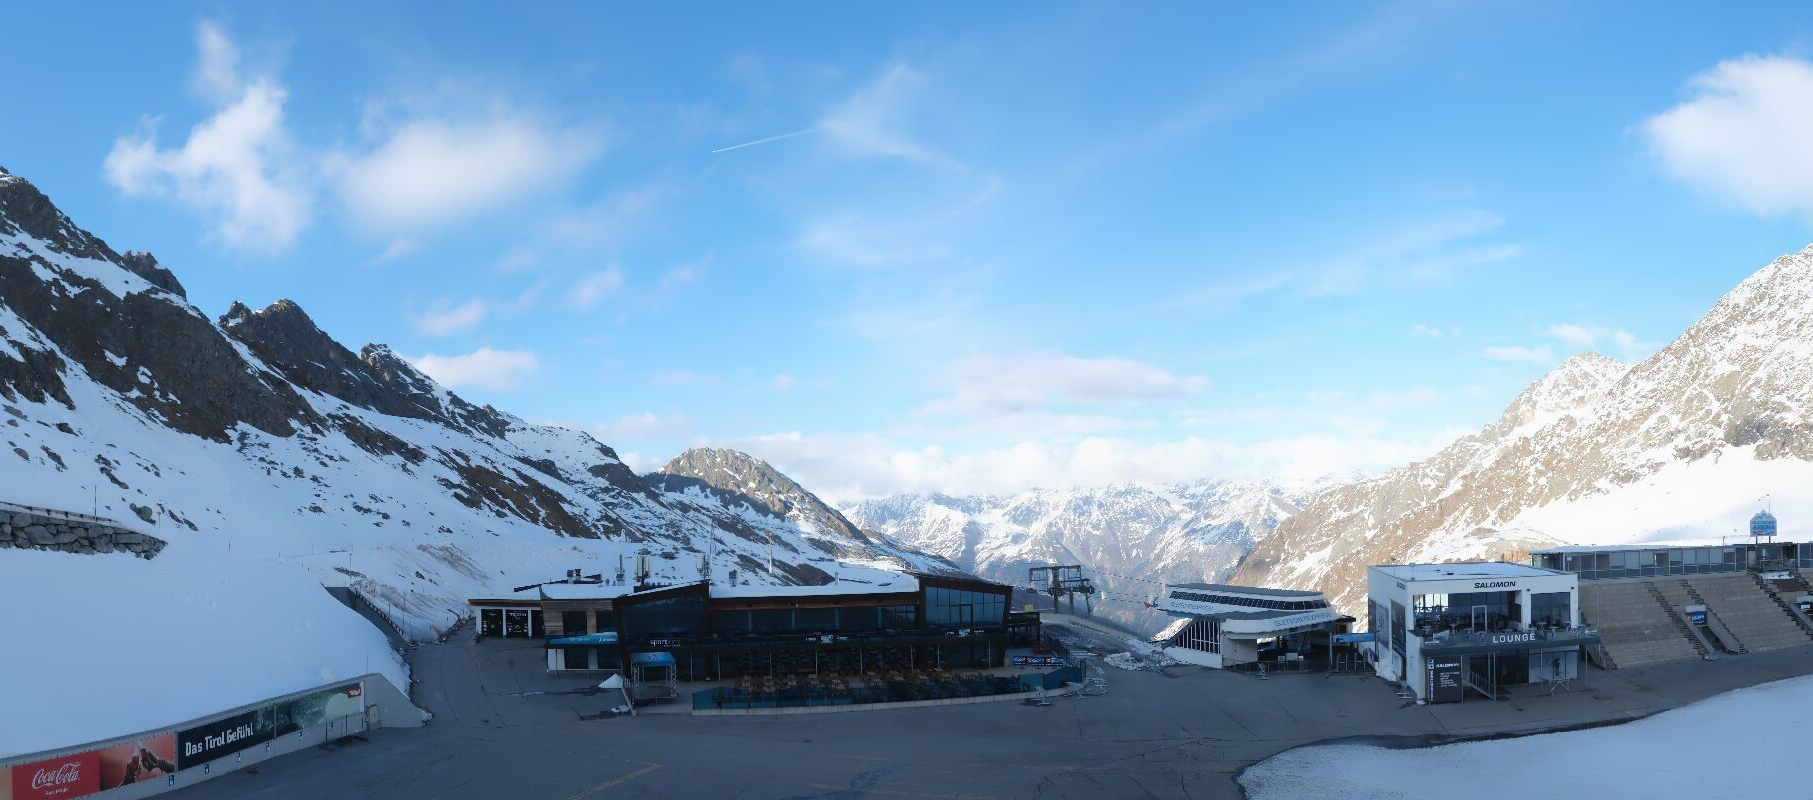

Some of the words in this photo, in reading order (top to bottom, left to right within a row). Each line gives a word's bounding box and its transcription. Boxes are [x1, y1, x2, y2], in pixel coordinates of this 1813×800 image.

[1474, 581, 1516, 589] SALOMON
[1492, 633, 1536, 643] LOUNGE
[185, 741, 203, 757] Das
[204, 731, 226, 751] Tirol
[226, 722, 254, 744] Gefühl
